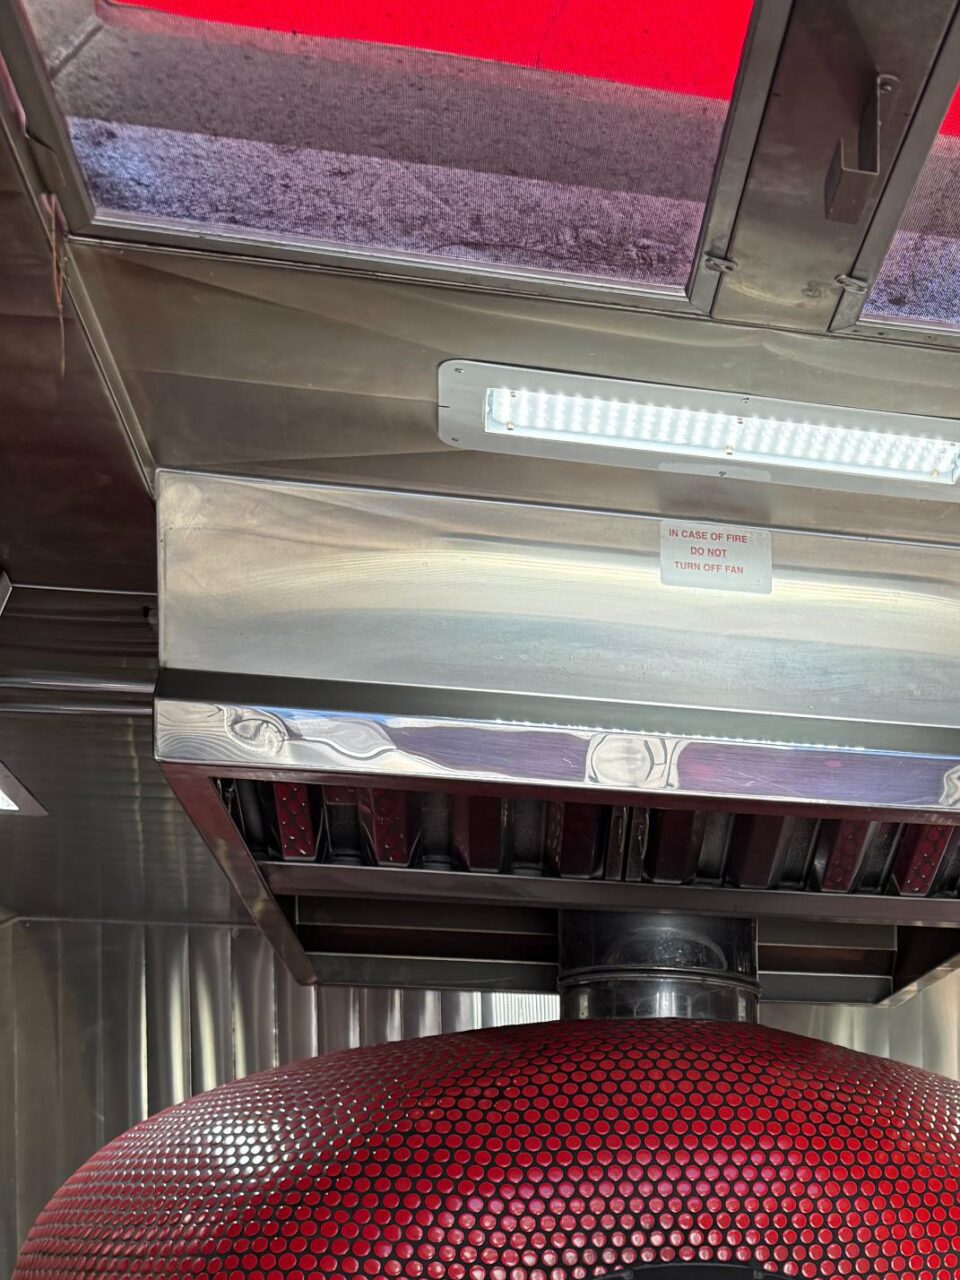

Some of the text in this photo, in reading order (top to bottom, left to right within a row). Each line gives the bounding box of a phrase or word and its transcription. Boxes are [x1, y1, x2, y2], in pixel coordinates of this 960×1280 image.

[669, 528, 748, 544] IN CASE OF FIRE
[690, 546, 727, 558] DO NOT
[674, 561, 744, 574] TURN OFF FAN
